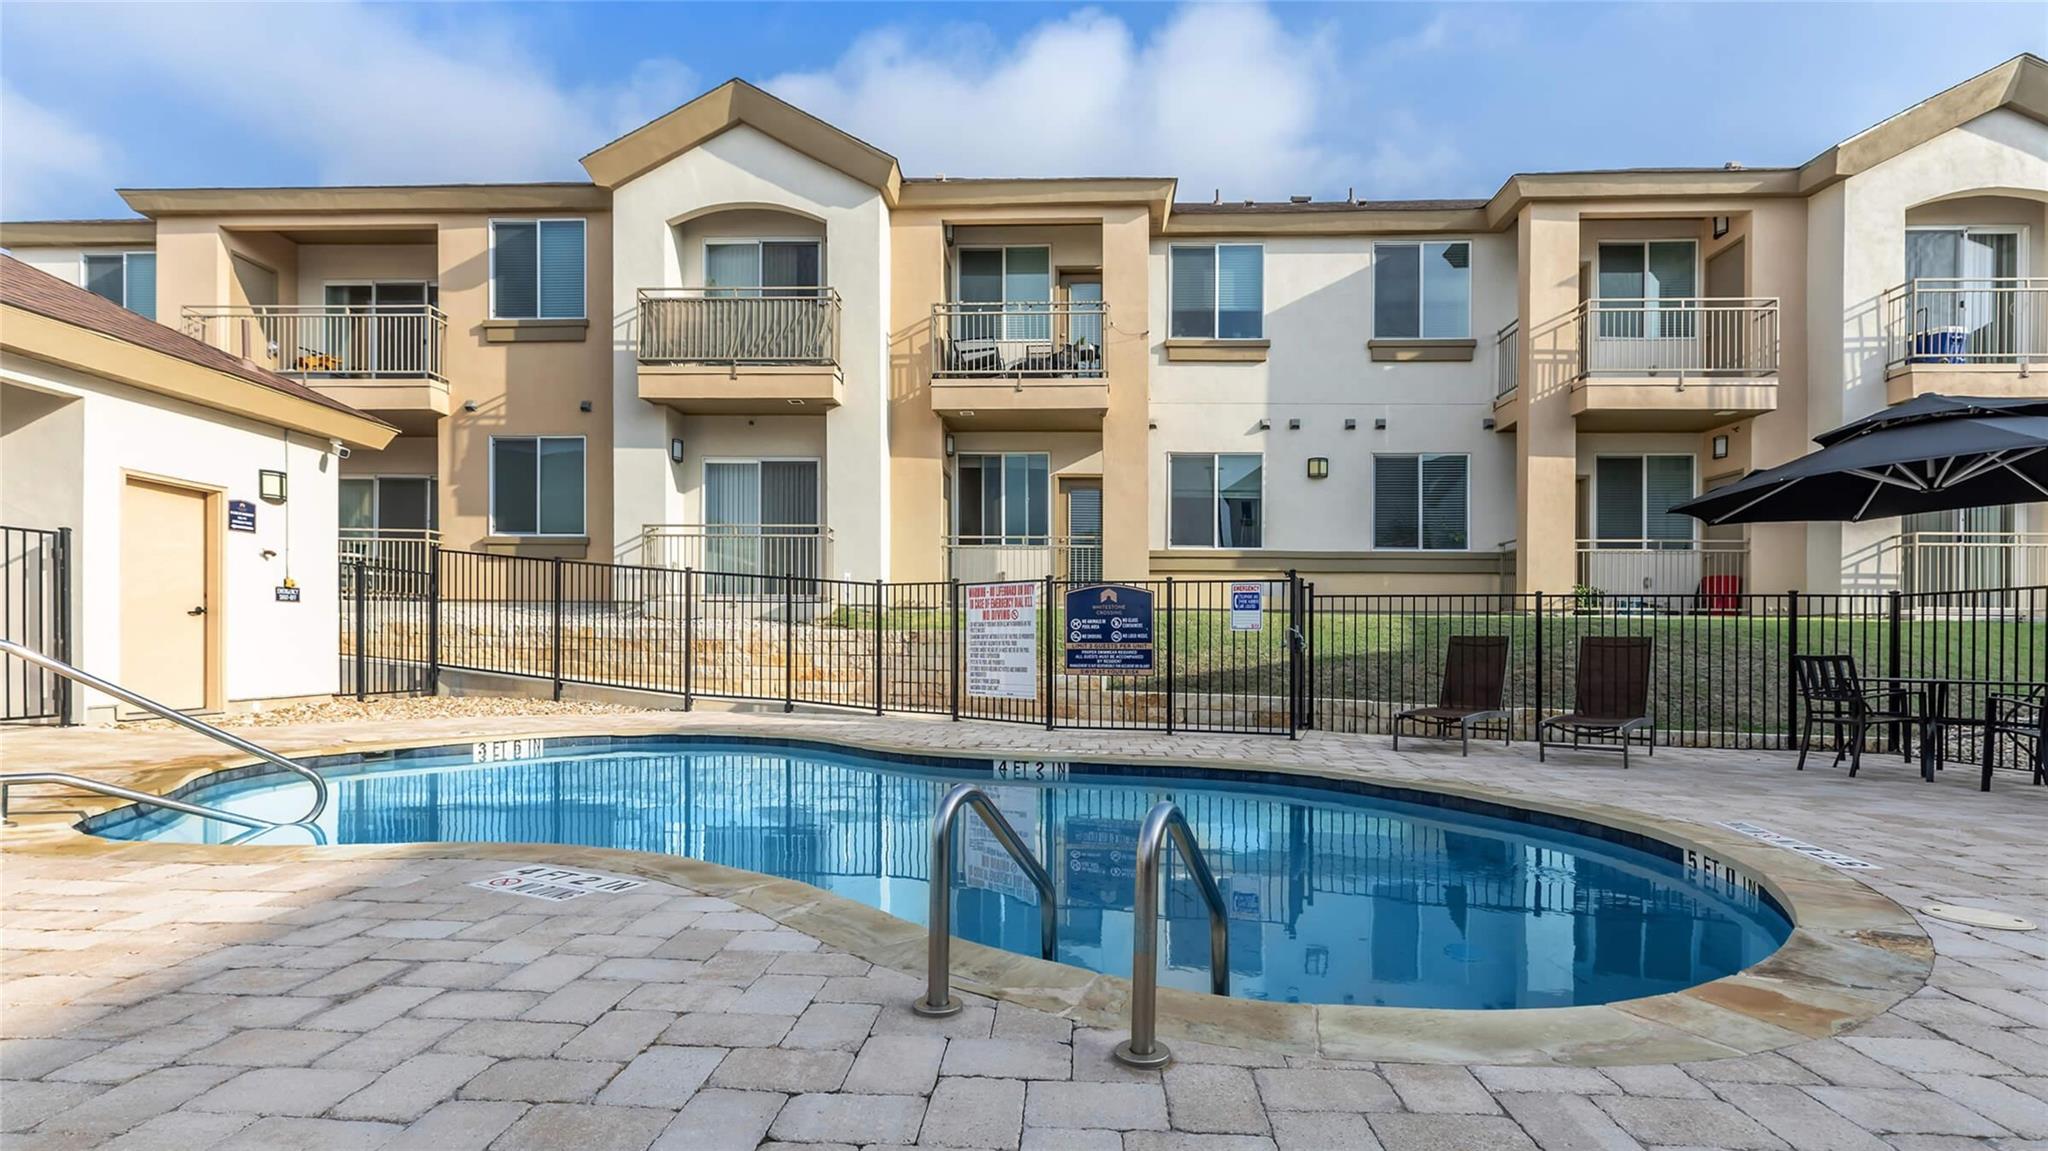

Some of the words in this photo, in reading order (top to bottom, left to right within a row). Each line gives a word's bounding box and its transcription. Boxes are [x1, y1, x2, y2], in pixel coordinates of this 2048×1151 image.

[996, 585, 1016, 596] LIFEGUARD
[1024, 584, 1034, 595] DUTY
[990, 597, 1014, 608] EMERGENCY
[982, 610, 990, 620] NO
[991, 609, 1010, 620] DIVING
[1688, 850, 1697, 870] 5
[1704, 856, 1719, 877] FT
[1743, 876, 1756, 896] IN
[517, 868, 545, 876] 4
[534, 870, 580, 881] FT
[570, 876, 602, 885] 2
[595, 880, 638, 892] IN
